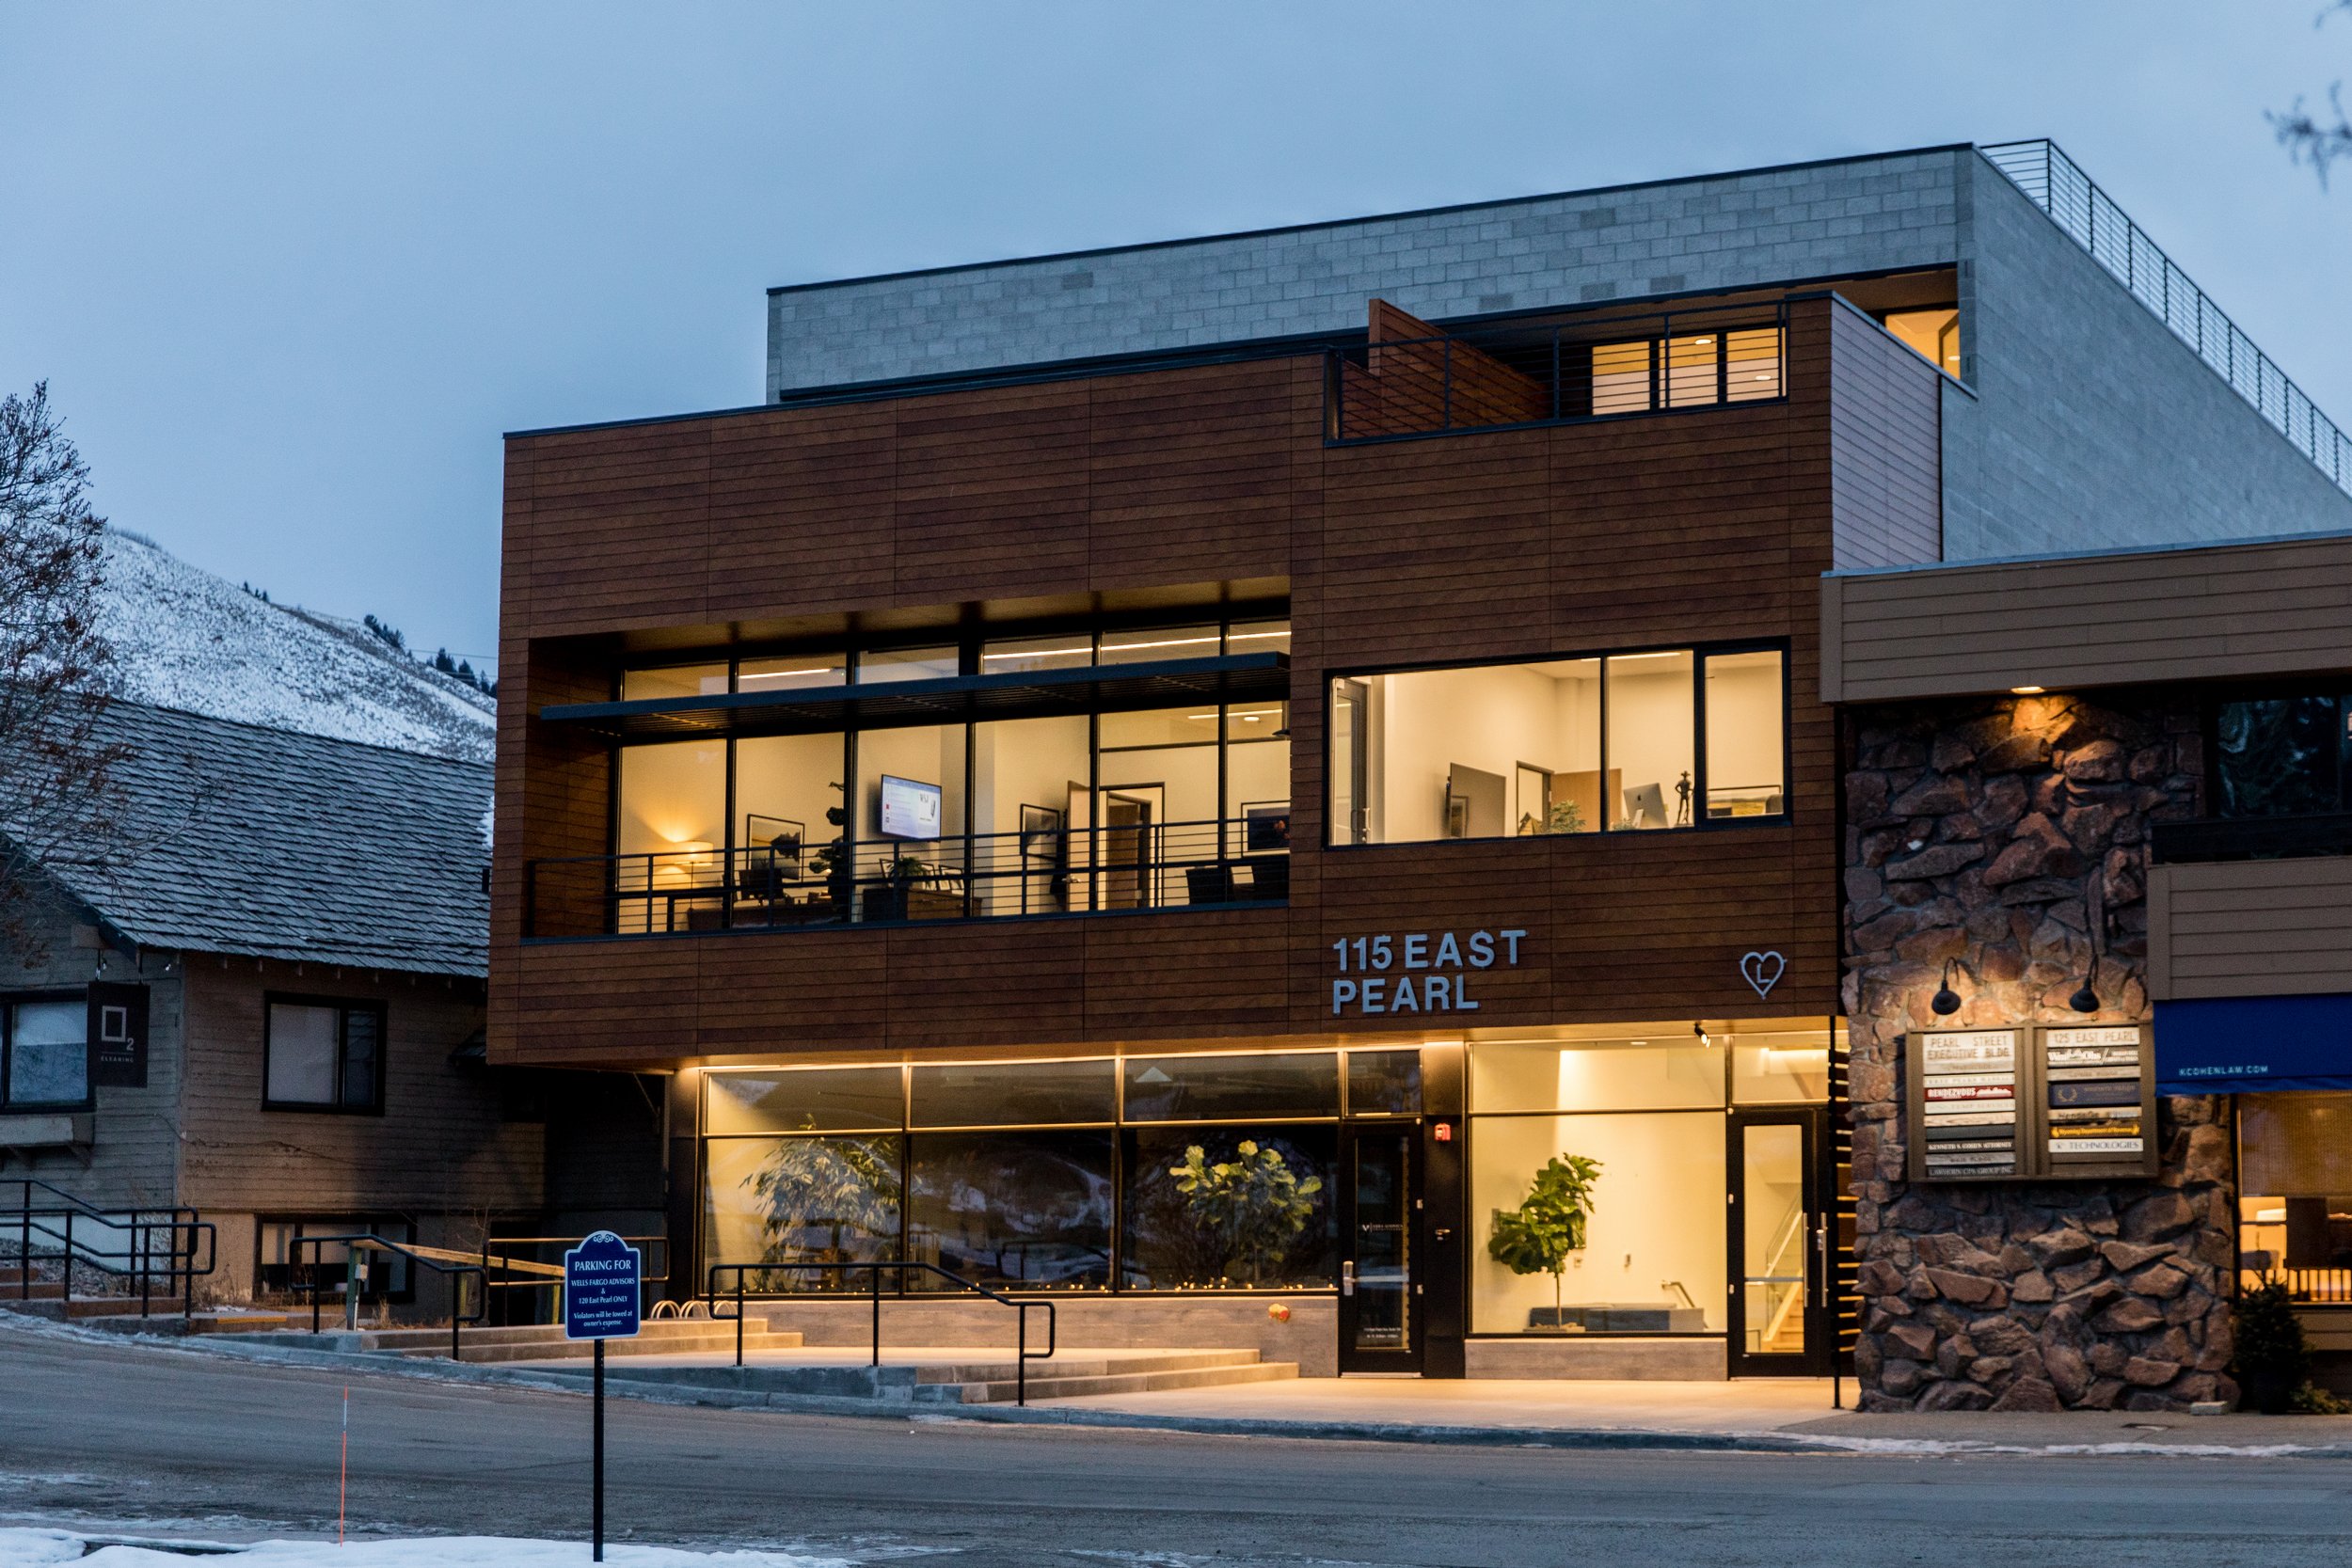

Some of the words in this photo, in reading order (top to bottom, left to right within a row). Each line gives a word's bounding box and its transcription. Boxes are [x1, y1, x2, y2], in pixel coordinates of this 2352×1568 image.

[1333, 934, 1392, 972] 115
[1405, 929, 1528, 969] EAST
[1332, 974, 1481, 1015] PEARL
[1931, 1037, 1961, 1048] PEARL
[1973, 1036, 2007, 1047] STREET
[2075, 1032, 2099, 1043] EAST
[2105, 1031, 2136, 1042] PEARL
[1927, 1048, 1978, 1060] EXECUTIVE
[2070, 1141, 2139, 1149] TECHNOLOGIES
[575, 1259, 612, 1271] PARKING
[614, 1259, 631, 1270] FOR
